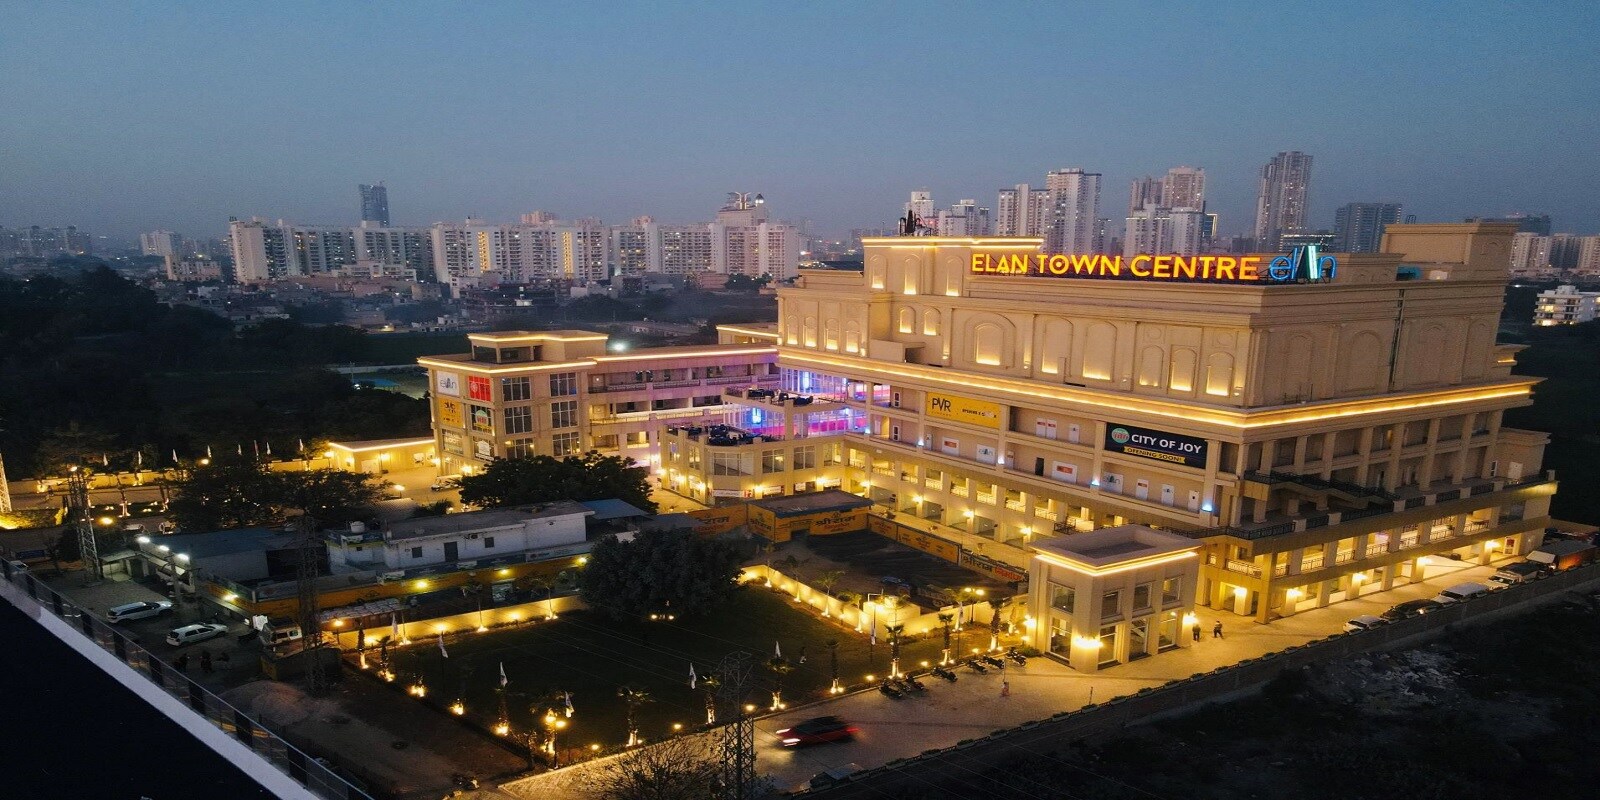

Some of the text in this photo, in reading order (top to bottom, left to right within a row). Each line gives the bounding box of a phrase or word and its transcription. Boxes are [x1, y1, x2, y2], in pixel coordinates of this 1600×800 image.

[971, 253, 1261, 281] ELAN TOWN CENTRE
[931, 397, 951, 412] PVR
[1127, 447, 1157, 458] OPENING
[1131, 434, 1157, 446] CITY
[1159, 439, 1176, 449] OF
[1178, 442, 1202, 454] JOY
